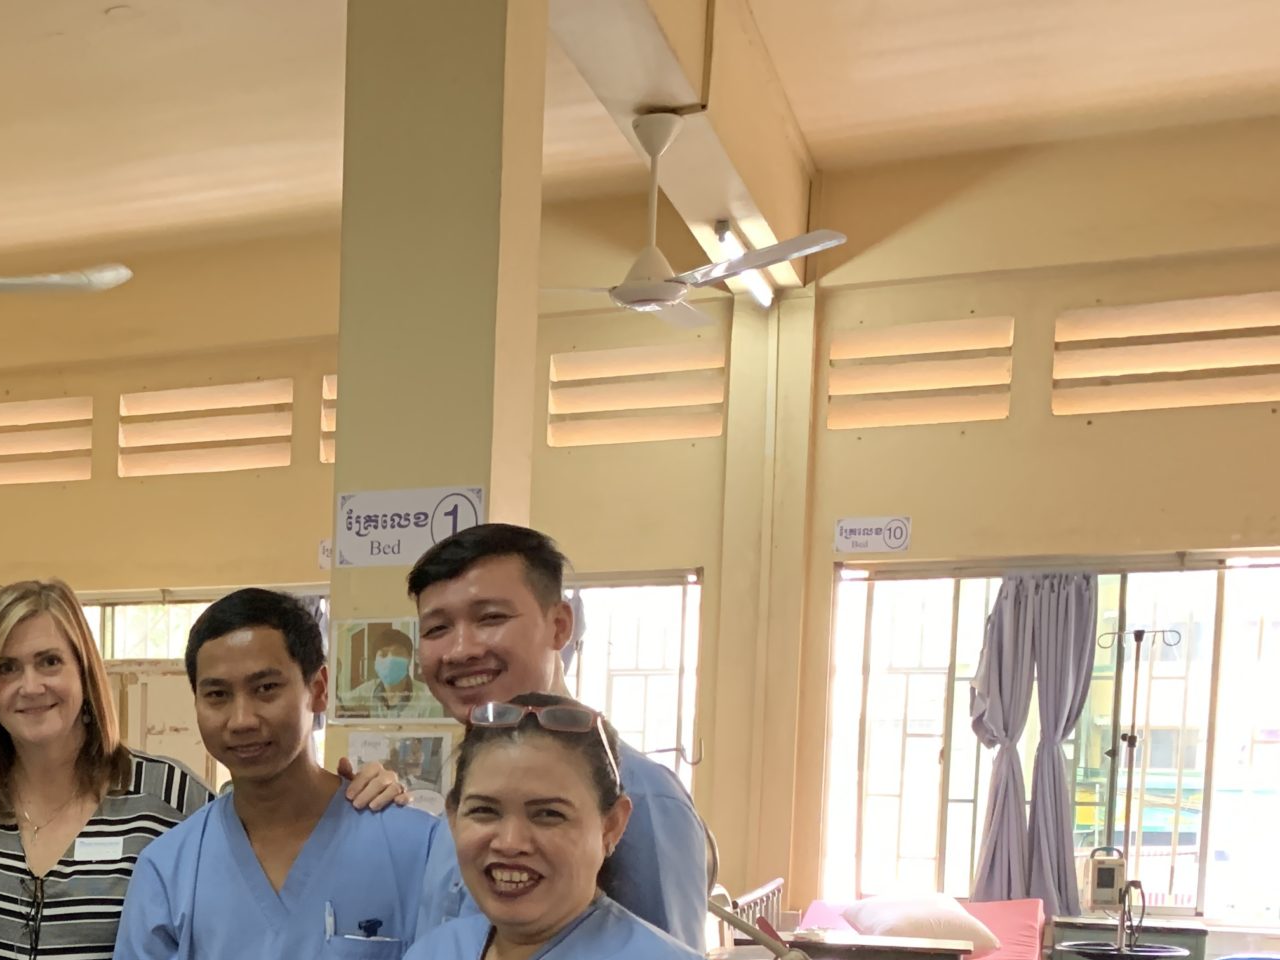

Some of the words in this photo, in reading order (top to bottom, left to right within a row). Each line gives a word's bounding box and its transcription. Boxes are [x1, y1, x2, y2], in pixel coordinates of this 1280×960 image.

[444, 503, 458, 537] 1
[886, 525, 904, 541] 10
[370, 539, 401, 556] Bed
